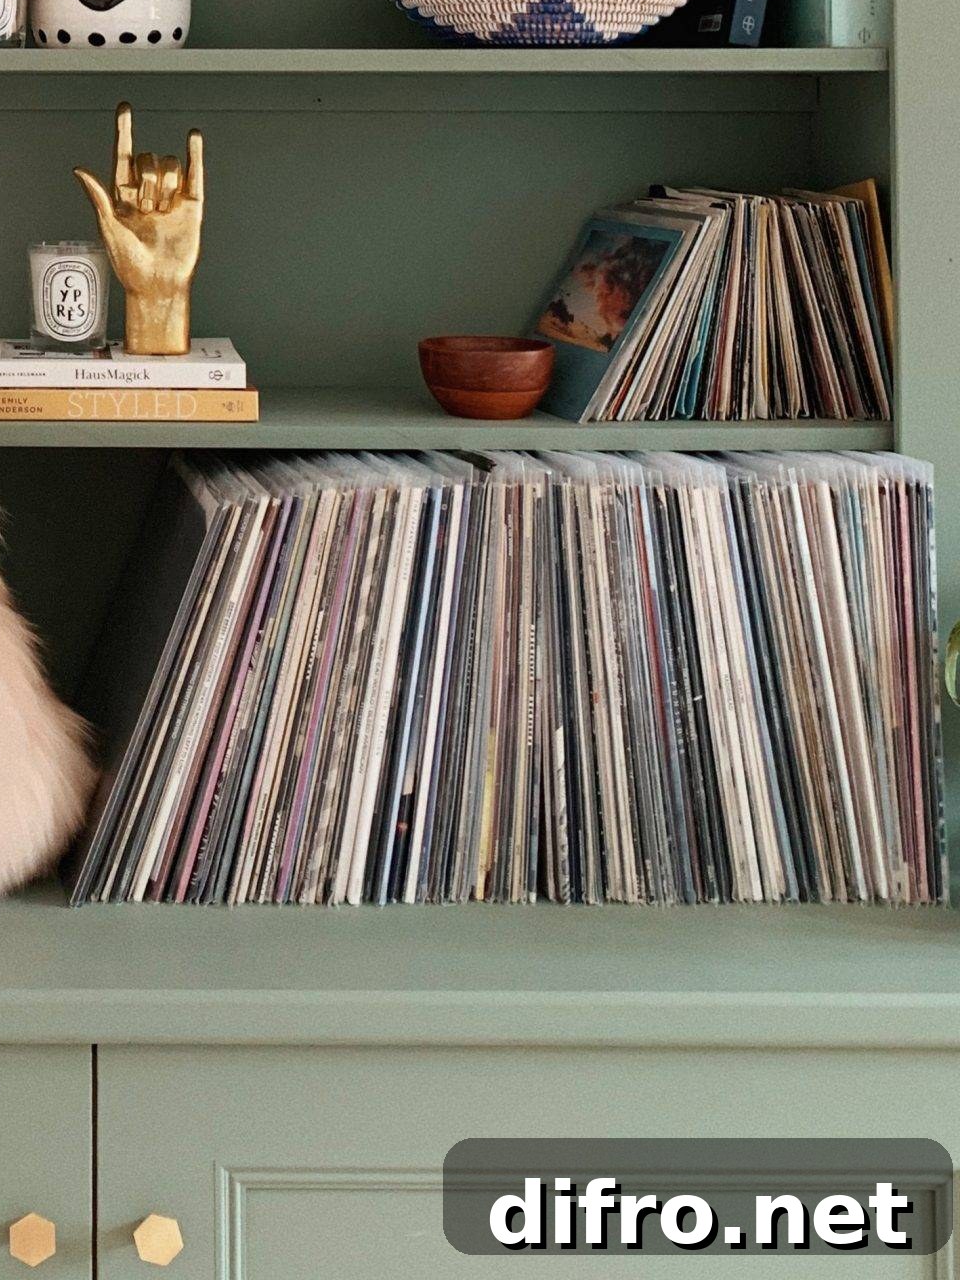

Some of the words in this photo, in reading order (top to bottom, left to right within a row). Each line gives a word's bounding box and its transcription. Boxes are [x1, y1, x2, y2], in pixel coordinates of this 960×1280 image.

[74, 368, 151, 383] HausMagick
[1, 397, 28, 405] EMILY
[68, 391, 197, 418] STYLED
